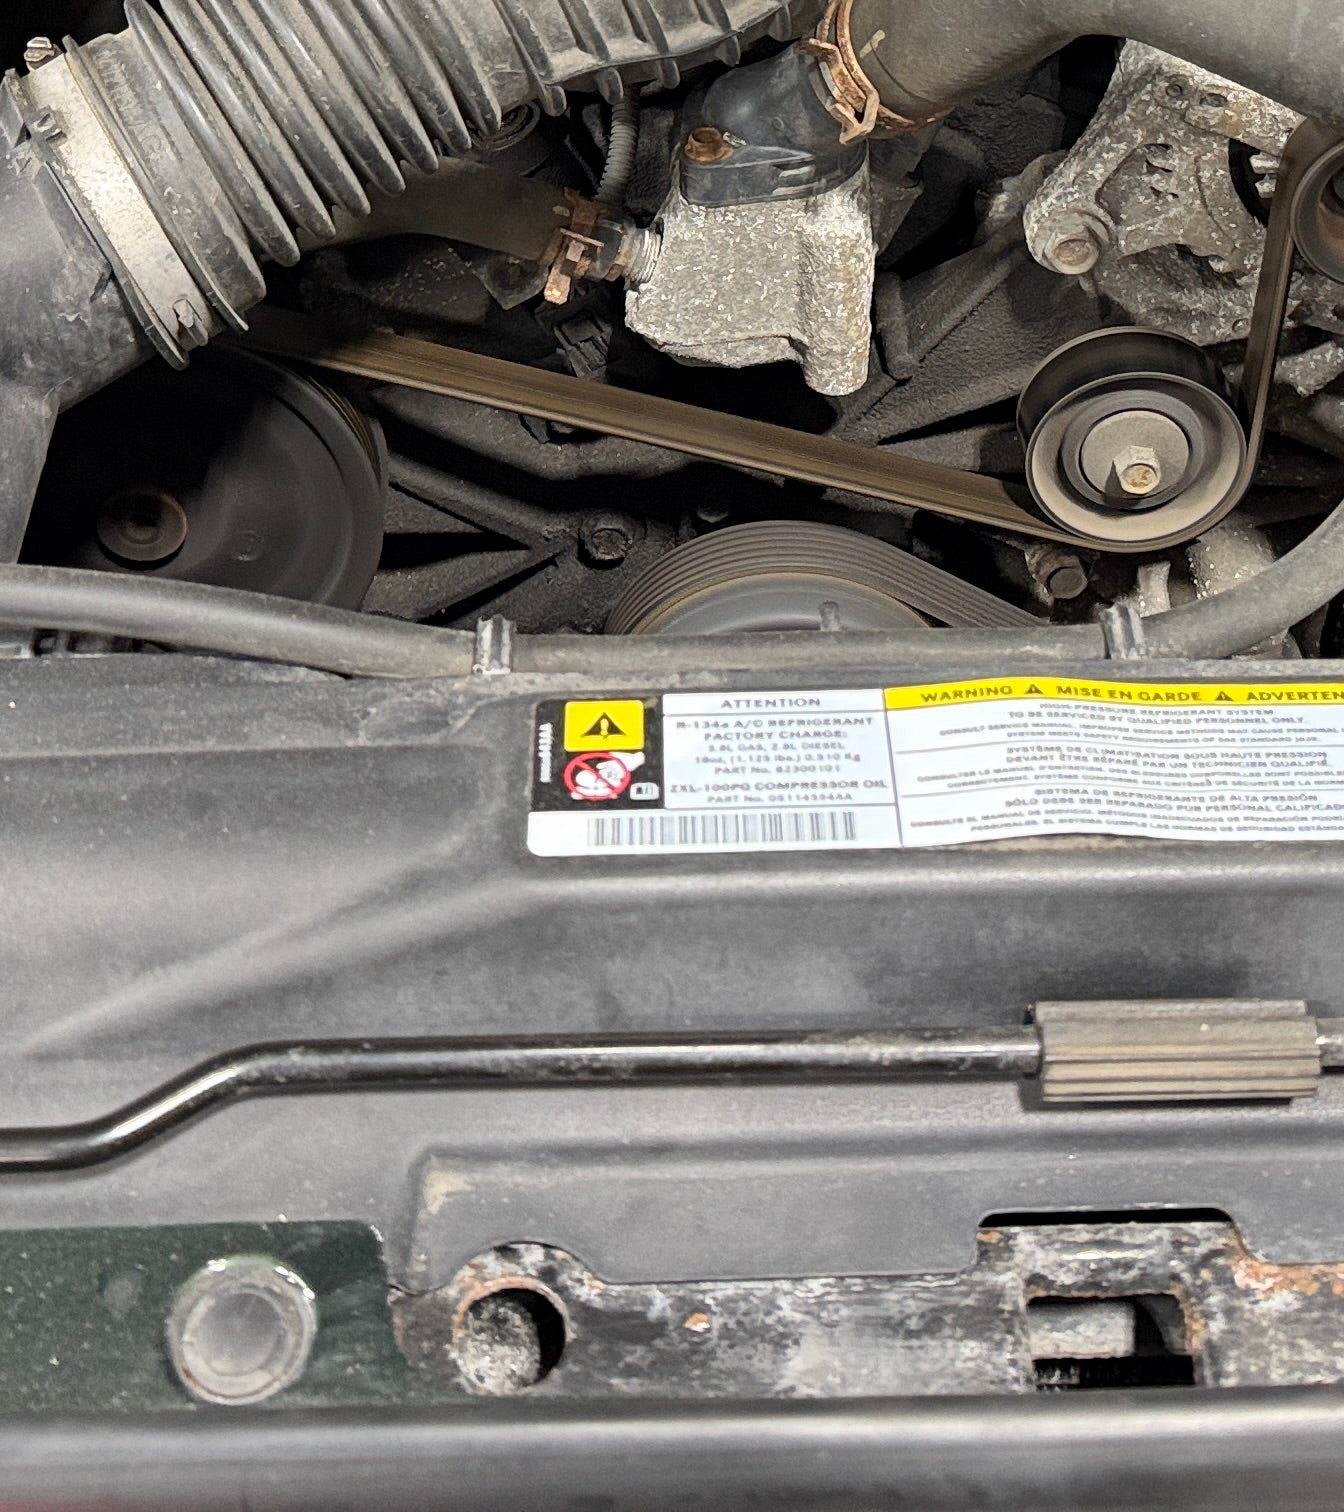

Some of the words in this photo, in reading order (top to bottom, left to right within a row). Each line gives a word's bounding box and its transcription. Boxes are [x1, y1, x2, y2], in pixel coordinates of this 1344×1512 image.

[921, 685, 1012, 702] WARNING
[1056, 686, 1101, 697] MISE
[1109, 689, 1132, 700] EN
[1138, 691, 1201, 701] GARDE
[720, 698, 823, 708] ATTENTION
[767, 718, 874, 726] REFRIGERANT
[705, 732, 772, 740] FACTORY
[862, 780, 888, 788] OIL
